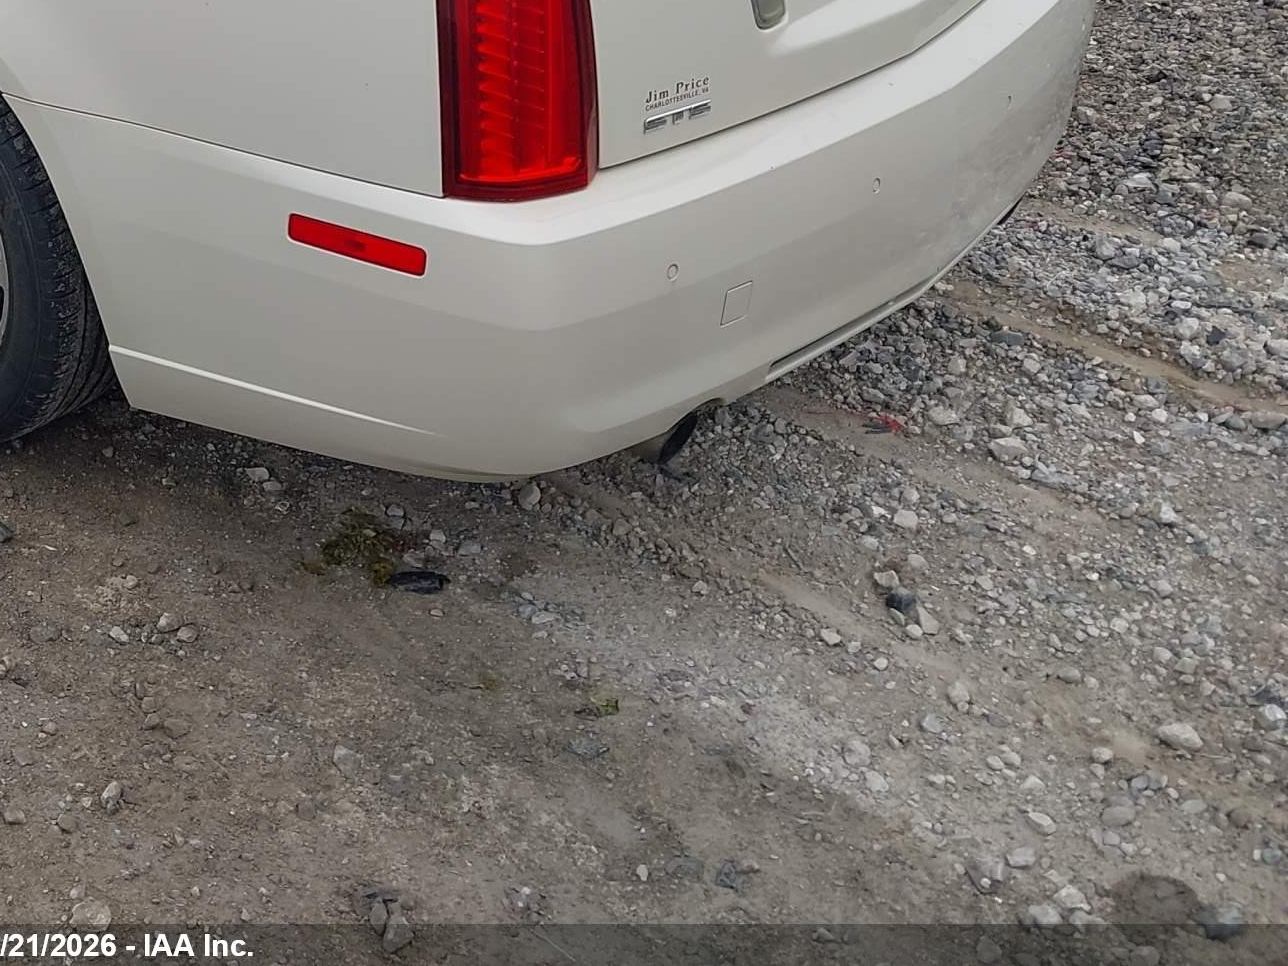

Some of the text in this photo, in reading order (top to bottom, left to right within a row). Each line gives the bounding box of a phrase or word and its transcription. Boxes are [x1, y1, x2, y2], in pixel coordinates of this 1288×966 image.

[645, 77, 709, 104] Jim Price
[644, 99, 712, 133] STS
